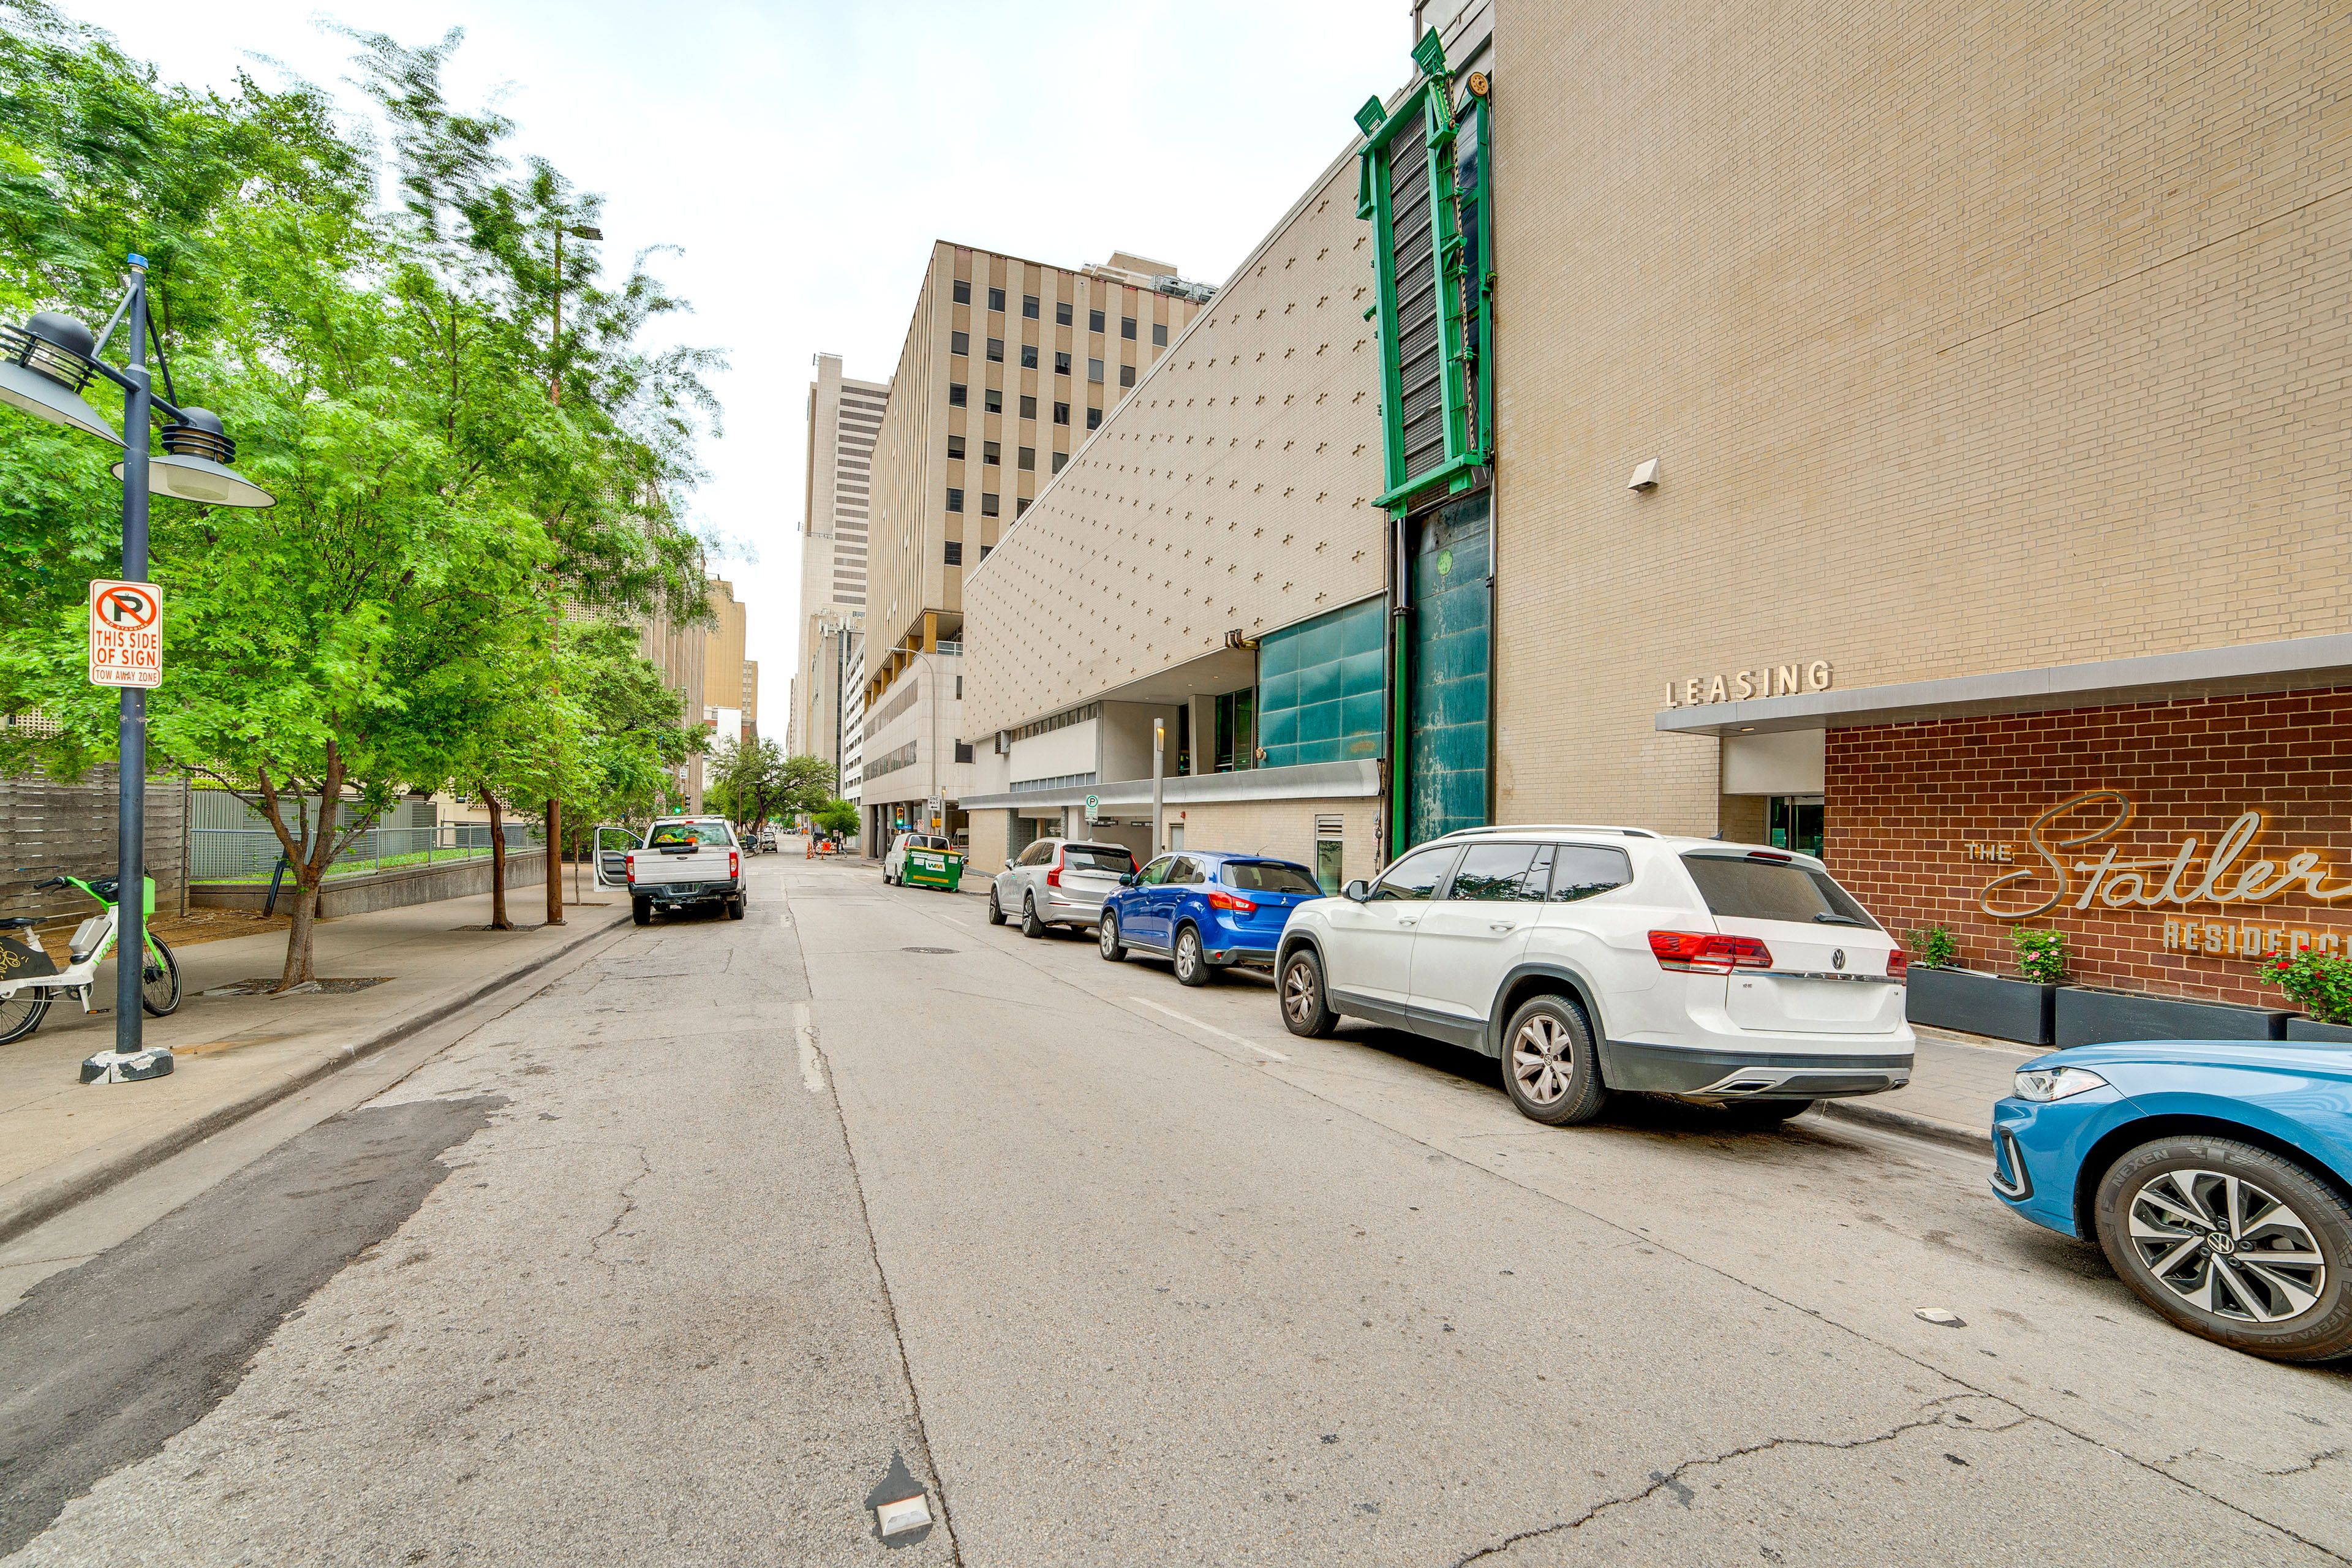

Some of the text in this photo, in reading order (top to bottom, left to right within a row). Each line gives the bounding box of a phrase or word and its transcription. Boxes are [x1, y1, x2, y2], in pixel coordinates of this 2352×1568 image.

[96, 630, 157, 649] THIS SIDE
[116, 622, 148, 631] STANDING
[97, 647, 156, 666] OF SIGN
[96, 670, 157, 682] TOW AWAY ZONE
[1665, 660, 1834, 708] LEASING
[1964, 790, 2352, 919] THE Statler
[92, 933, 118, 967] Lime
[2111, 1149, 2170, 1188] NEXEN
